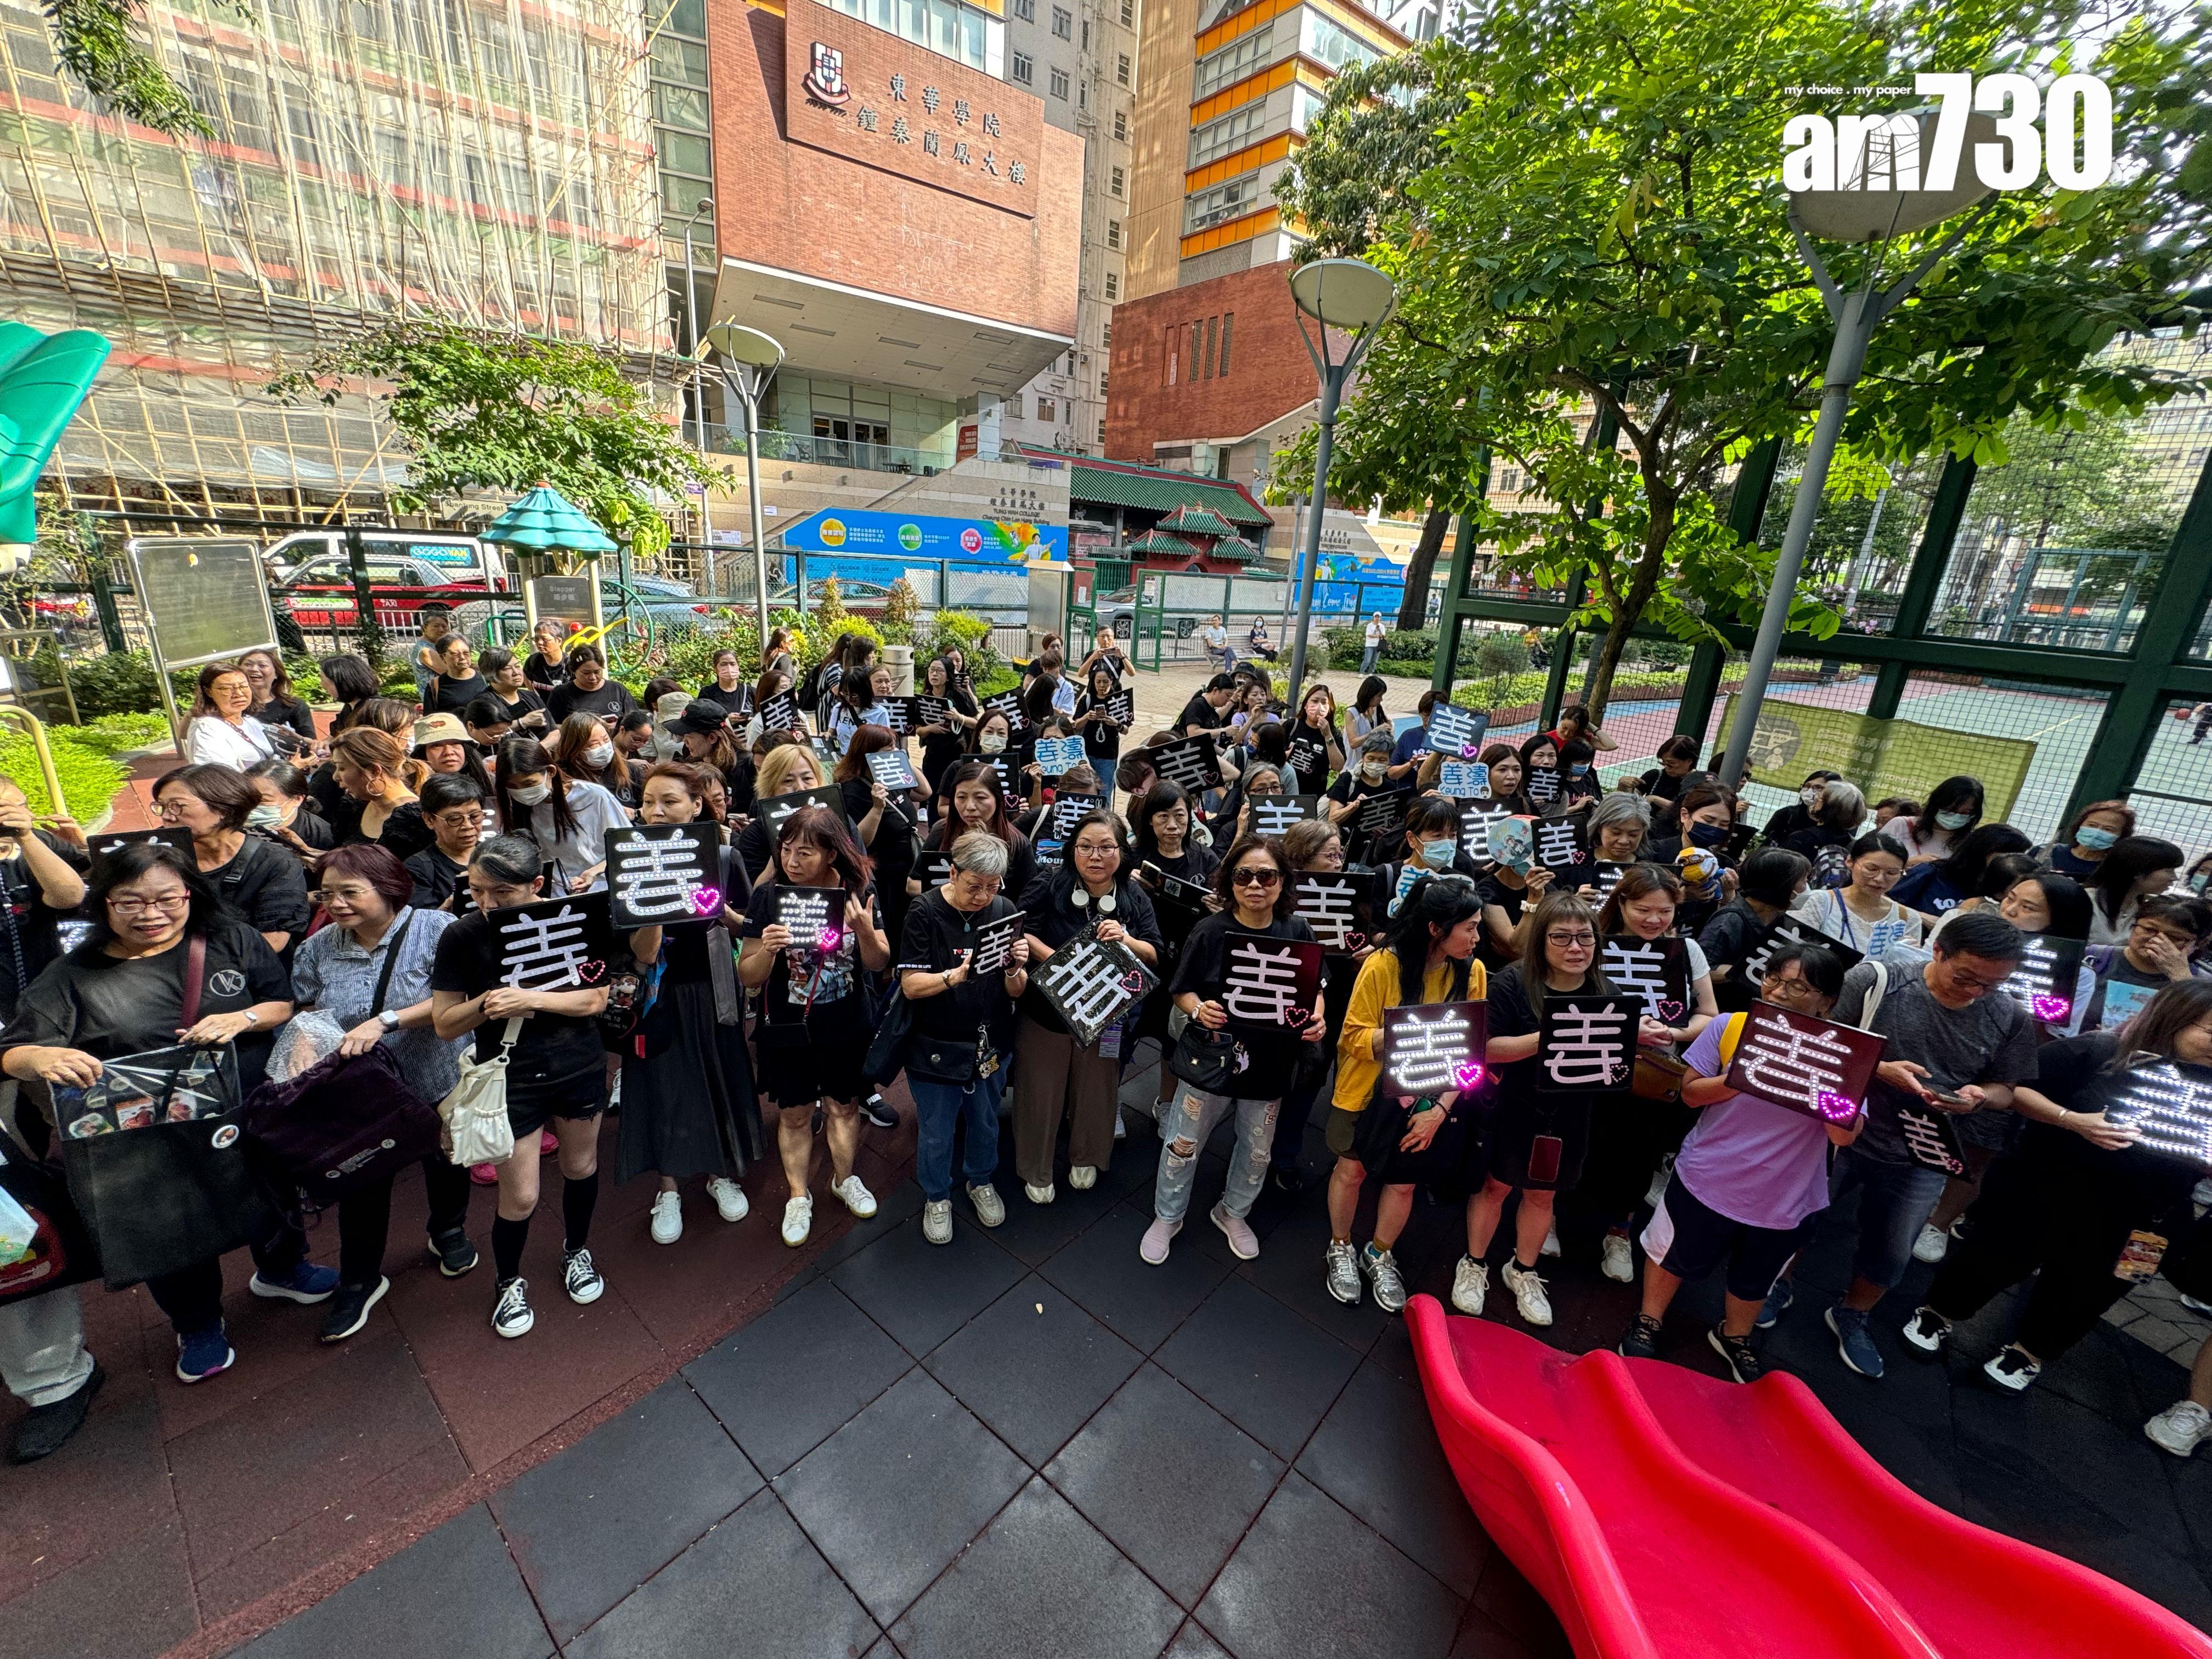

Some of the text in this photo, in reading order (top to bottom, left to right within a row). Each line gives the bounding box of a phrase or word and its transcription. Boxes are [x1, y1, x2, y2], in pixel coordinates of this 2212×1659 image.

[887, 73, 1001, 138] 東華學院
[1440, 786, 1479, 797] Keung To
